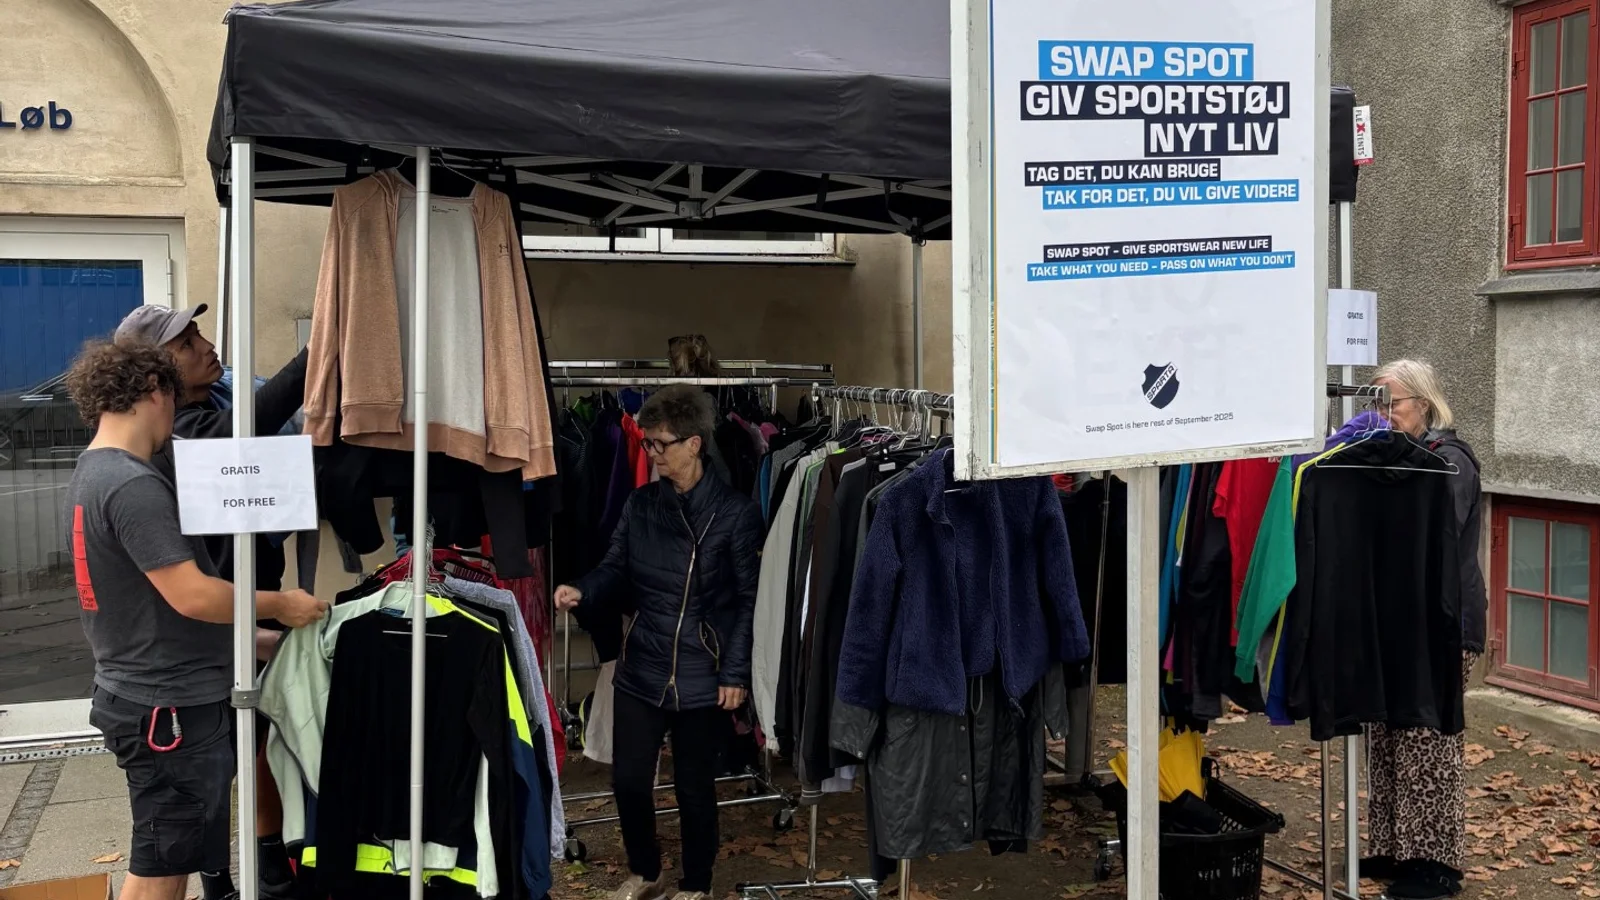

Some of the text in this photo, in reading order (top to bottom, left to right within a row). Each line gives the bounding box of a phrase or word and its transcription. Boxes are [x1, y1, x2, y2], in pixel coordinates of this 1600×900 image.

[1051, 45, 1249, 77] SWAP SPOT
[1025, 84, 1284, 116] GIV SPORTSTØJ
[0, 100, 73, 131] Løb
[1149, 121, 1275, 153] NYT LIV
[1027, 163, 1218, 183] TAG DET, DU KAN BRUGE
[1045, 183, 1296, 205] TAK FOR DET, DU VIL GIVE VIDERE
[1046, 247, 1080, 259] SWAP
[1082, 245, 1111, 257] SPOT
[1122, 245, 1147, 255] GIVE
[1148, 241, 1220, 253] SPORTSWEAR
[1222, 240, 1247, 250] NEW
[1248, 239, 1269, 249] LIFE
[1030, 266, 1058, 277] TAKE
[1060, 264, 1093, 275] WHAT
[1095, 263, 1118, 273] YOU
[1120, 261, 1149, 272] NEED
[1160, 260, 1188, 270] PASS
[1189, 259, 1206, 269] ON
[1207, 257, 1239, 268] WHAT
[1240, 256, 1261, 266] YOU
[1262, 254, 1293, 265] DON'T
[1346, 337, 1357, 346] FOR
[1146, 365, 1175, 401] SPARTA
[1085, 412, 1234, 433] Swap Spot is here rest of September 2025
[221, 465, 261, 475] GRATIS
[223, 497, 276, 508] FOR FREE
